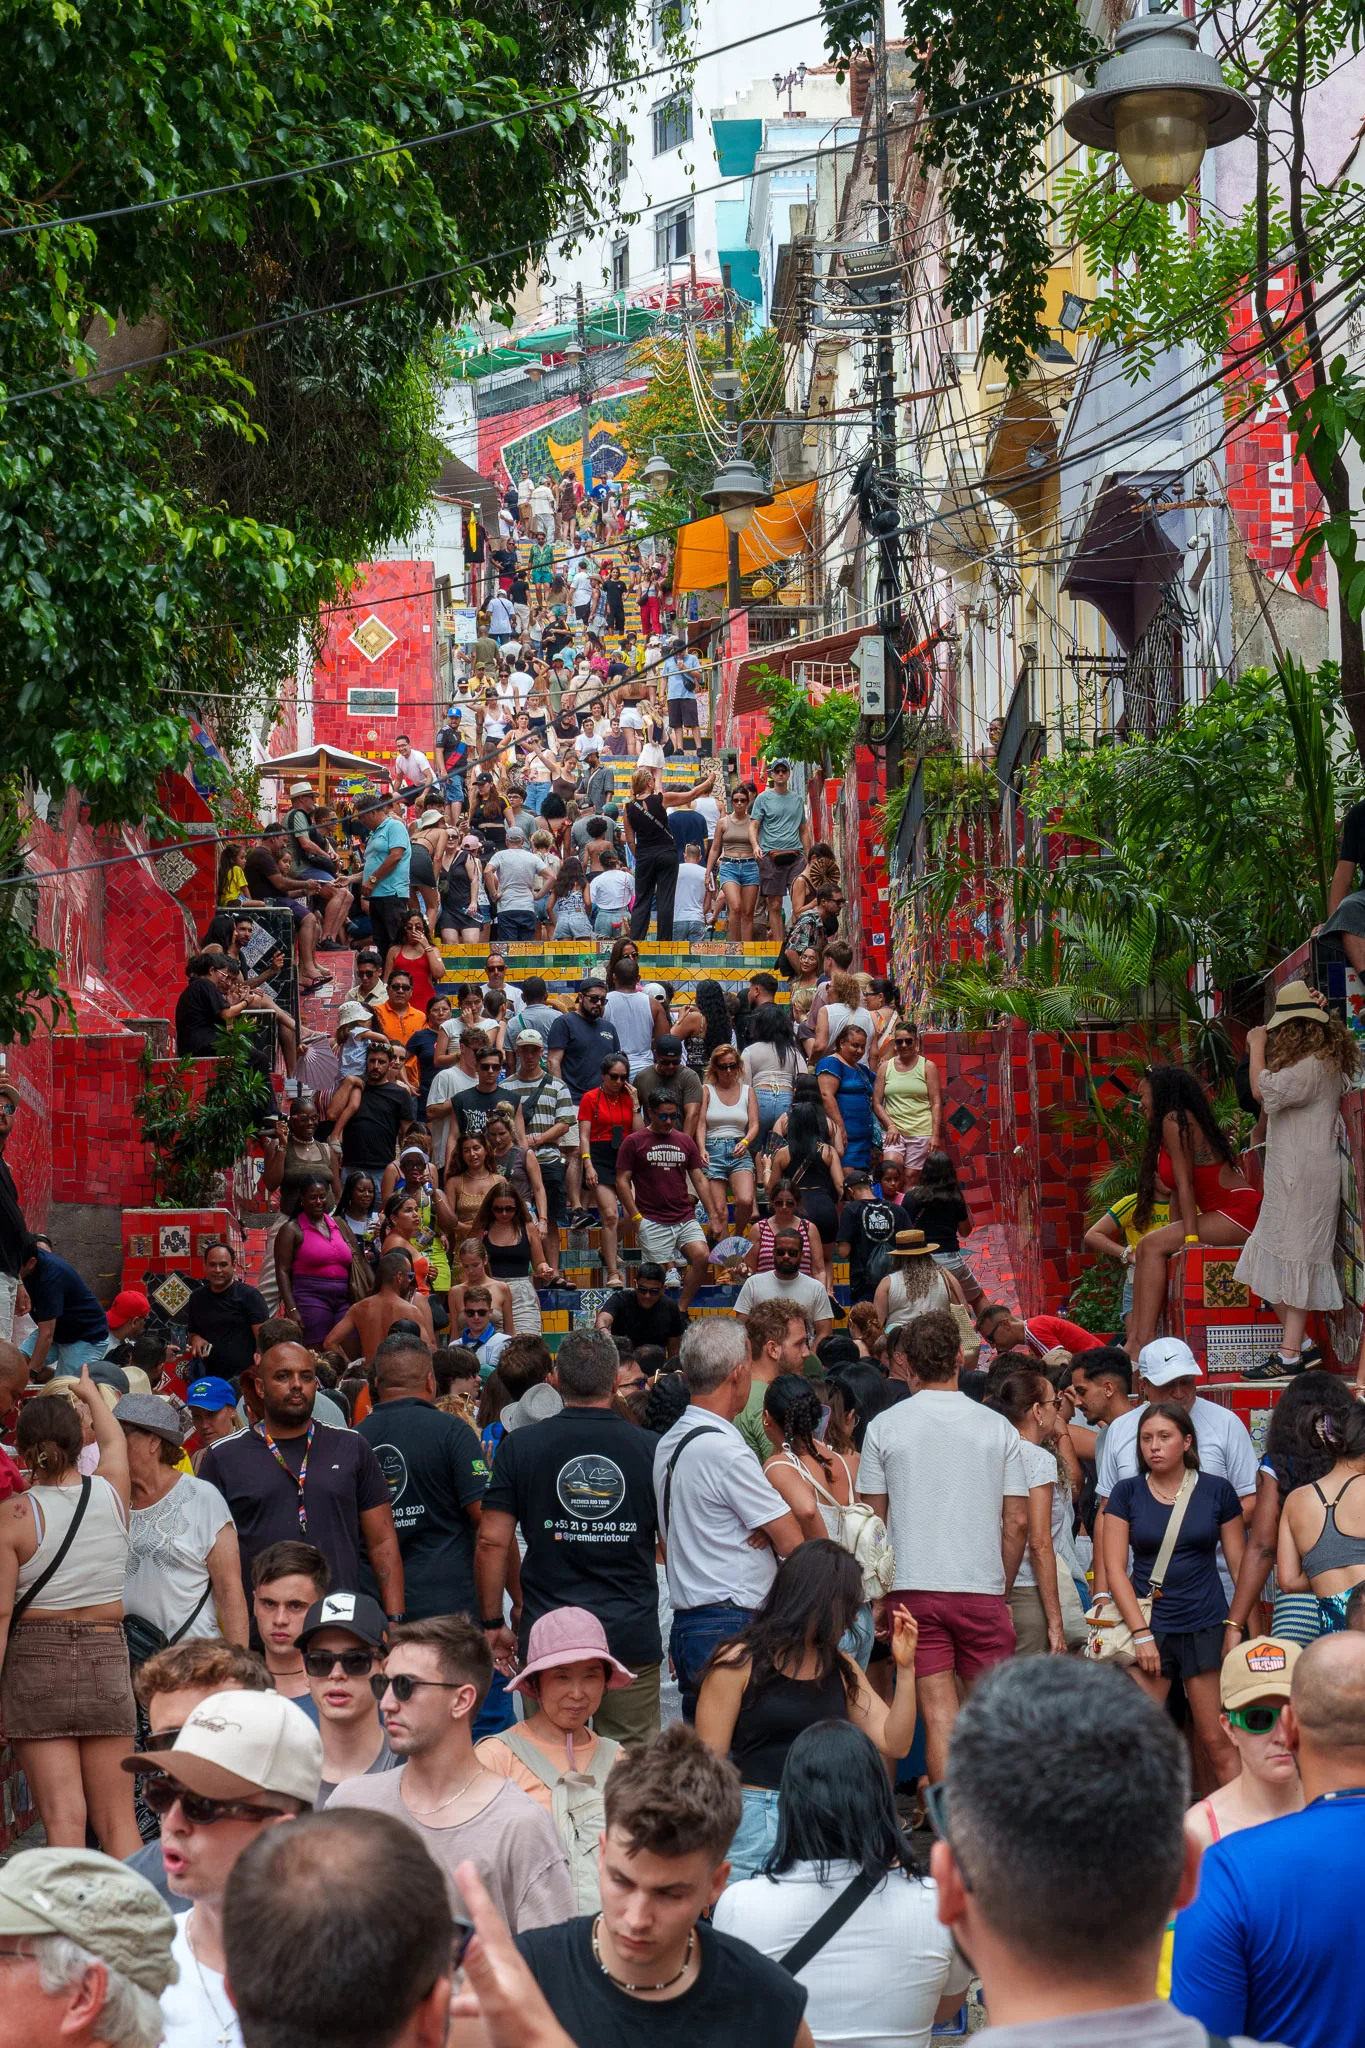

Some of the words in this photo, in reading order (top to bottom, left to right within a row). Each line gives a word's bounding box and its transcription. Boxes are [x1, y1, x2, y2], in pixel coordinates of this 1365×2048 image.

[405, 1505, 425, 1516] 8220
[554, 1520, 569, 1529] +55
[570, 1521, 579, 1531] 21
[581, 1522, 588, 1532] 9
[591, 1522, 617, 1532] 5940
[619, 1522, 638, 1532] 8220
[563, 1532, 630, 1542] @premierriotour
